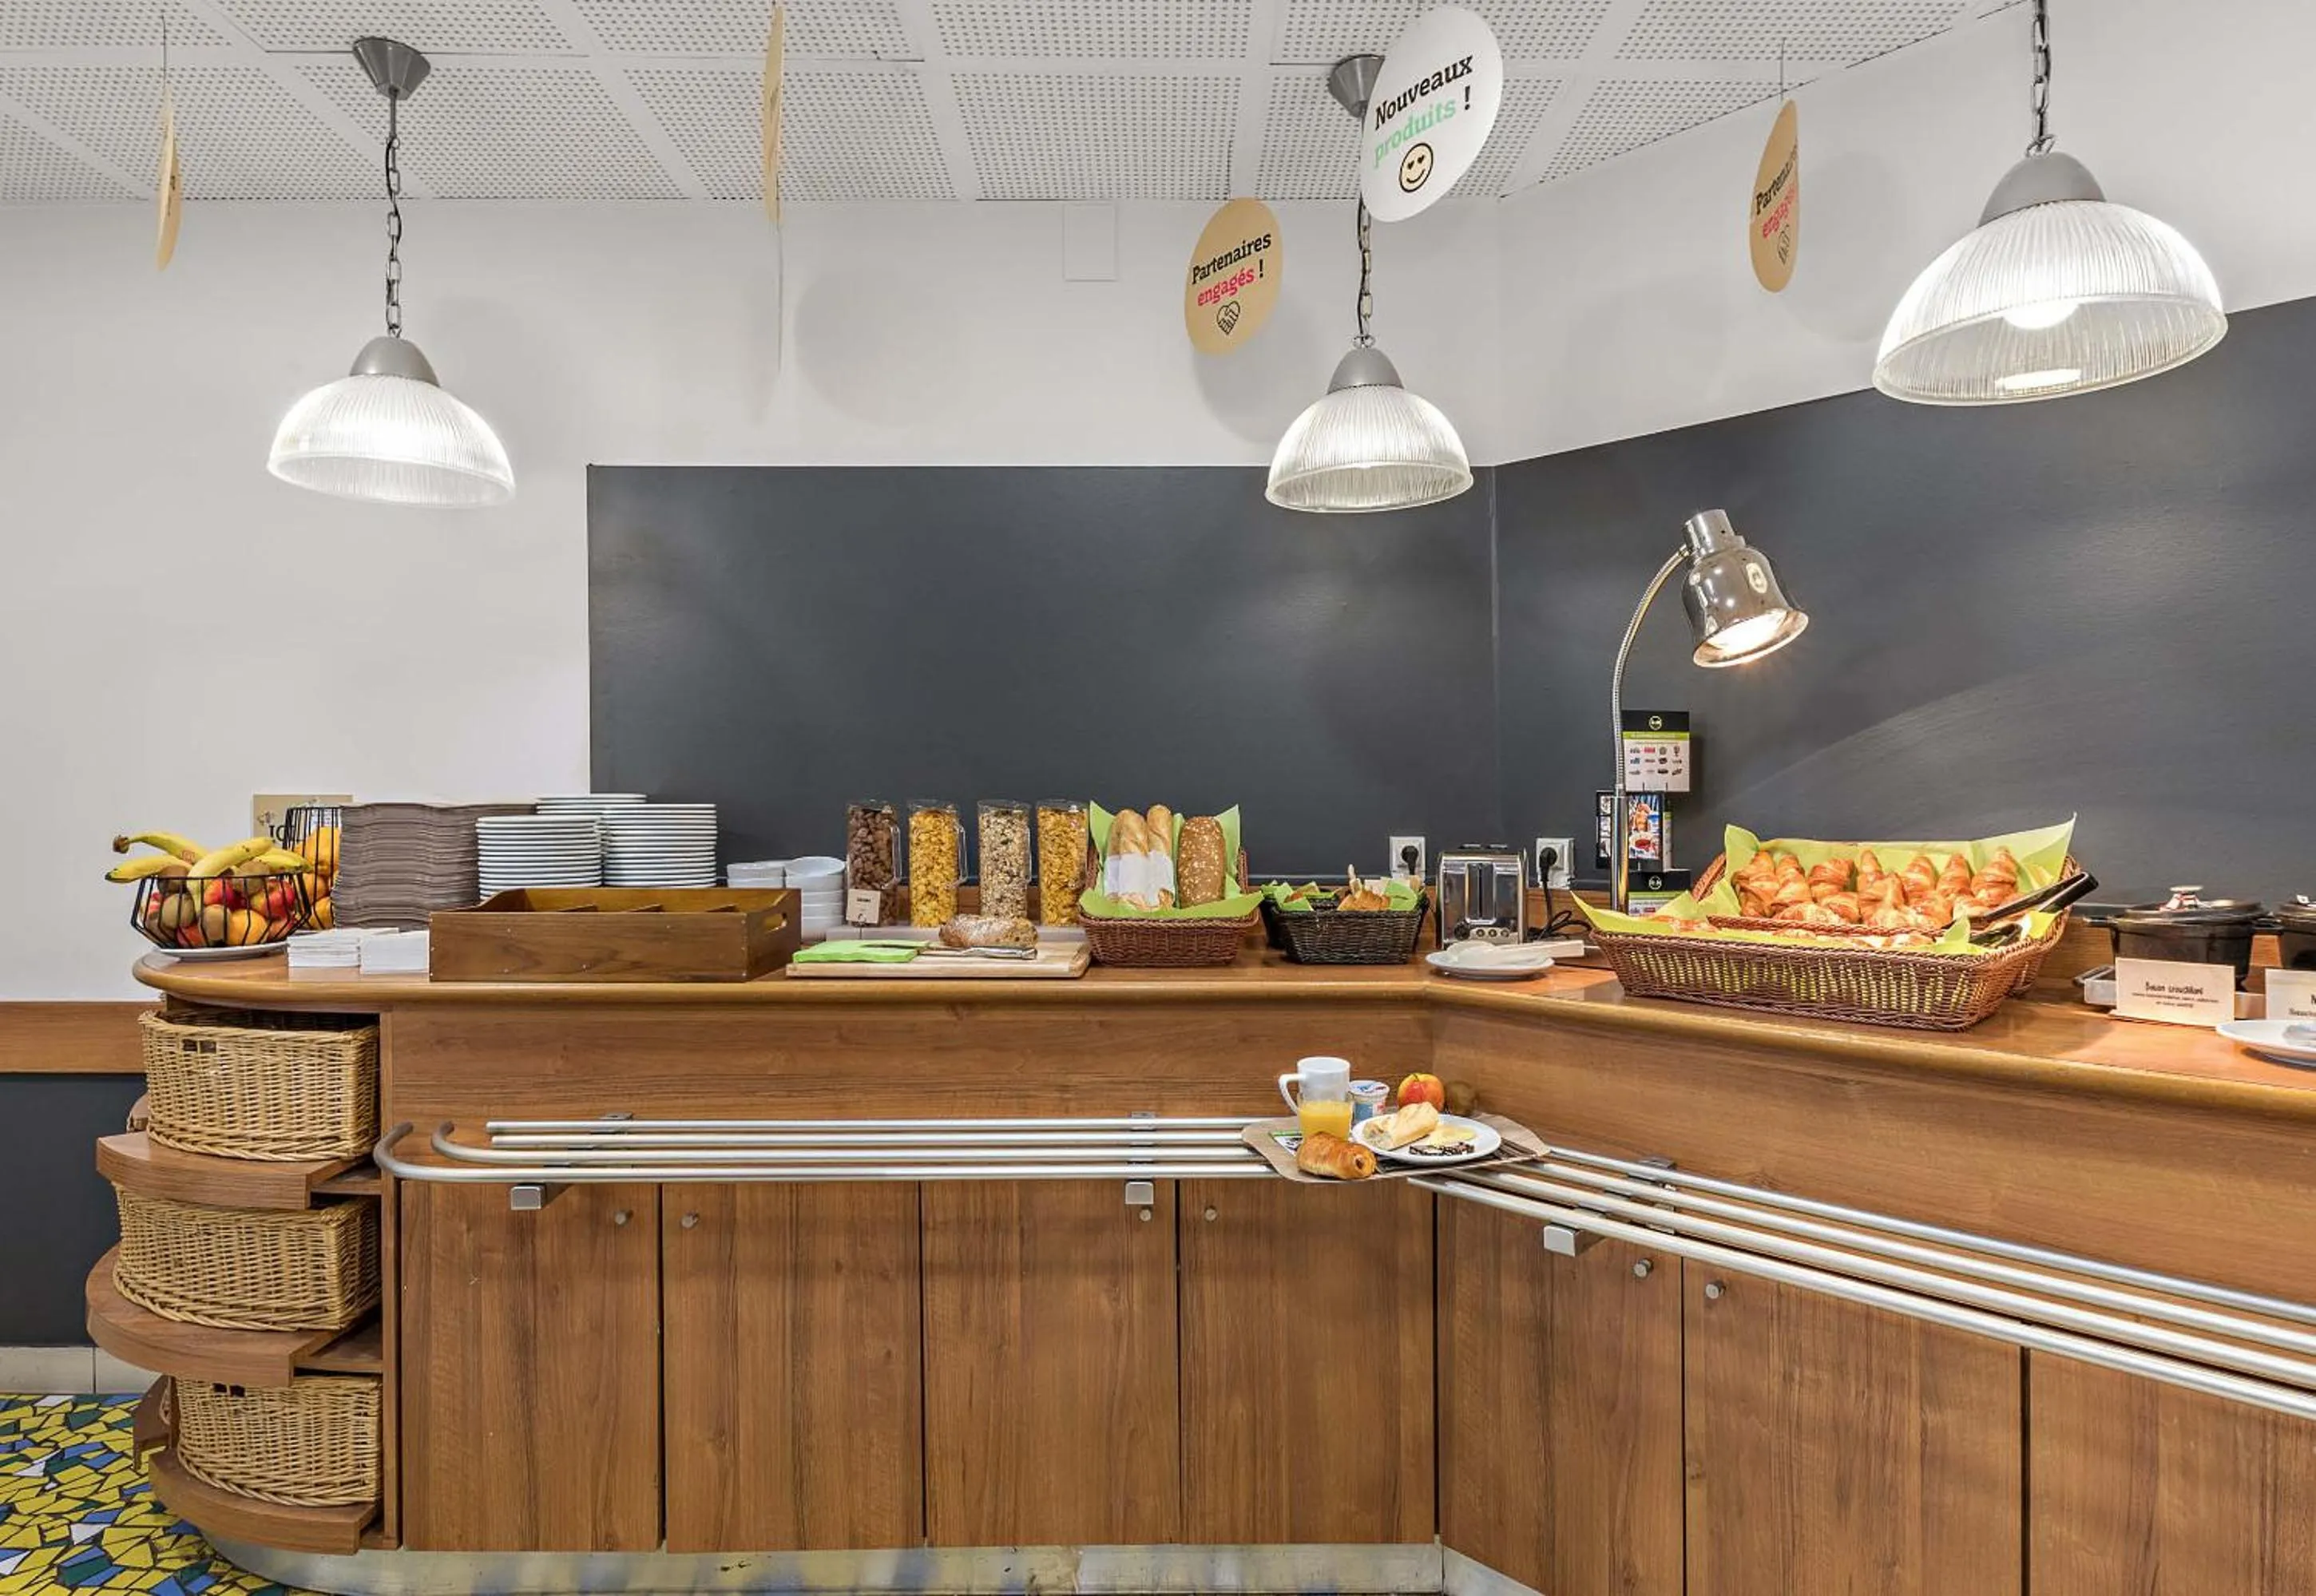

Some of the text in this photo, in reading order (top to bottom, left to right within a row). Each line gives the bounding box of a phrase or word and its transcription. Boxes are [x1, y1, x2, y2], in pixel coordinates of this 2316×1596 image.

[1374, 55, 1473, 131] Nouveaux
[1374, 85, 1470, 169] produits !
[1192, 233, 1271, 284] Partenaires
[1198, 259, 1263, 306] engagés !
